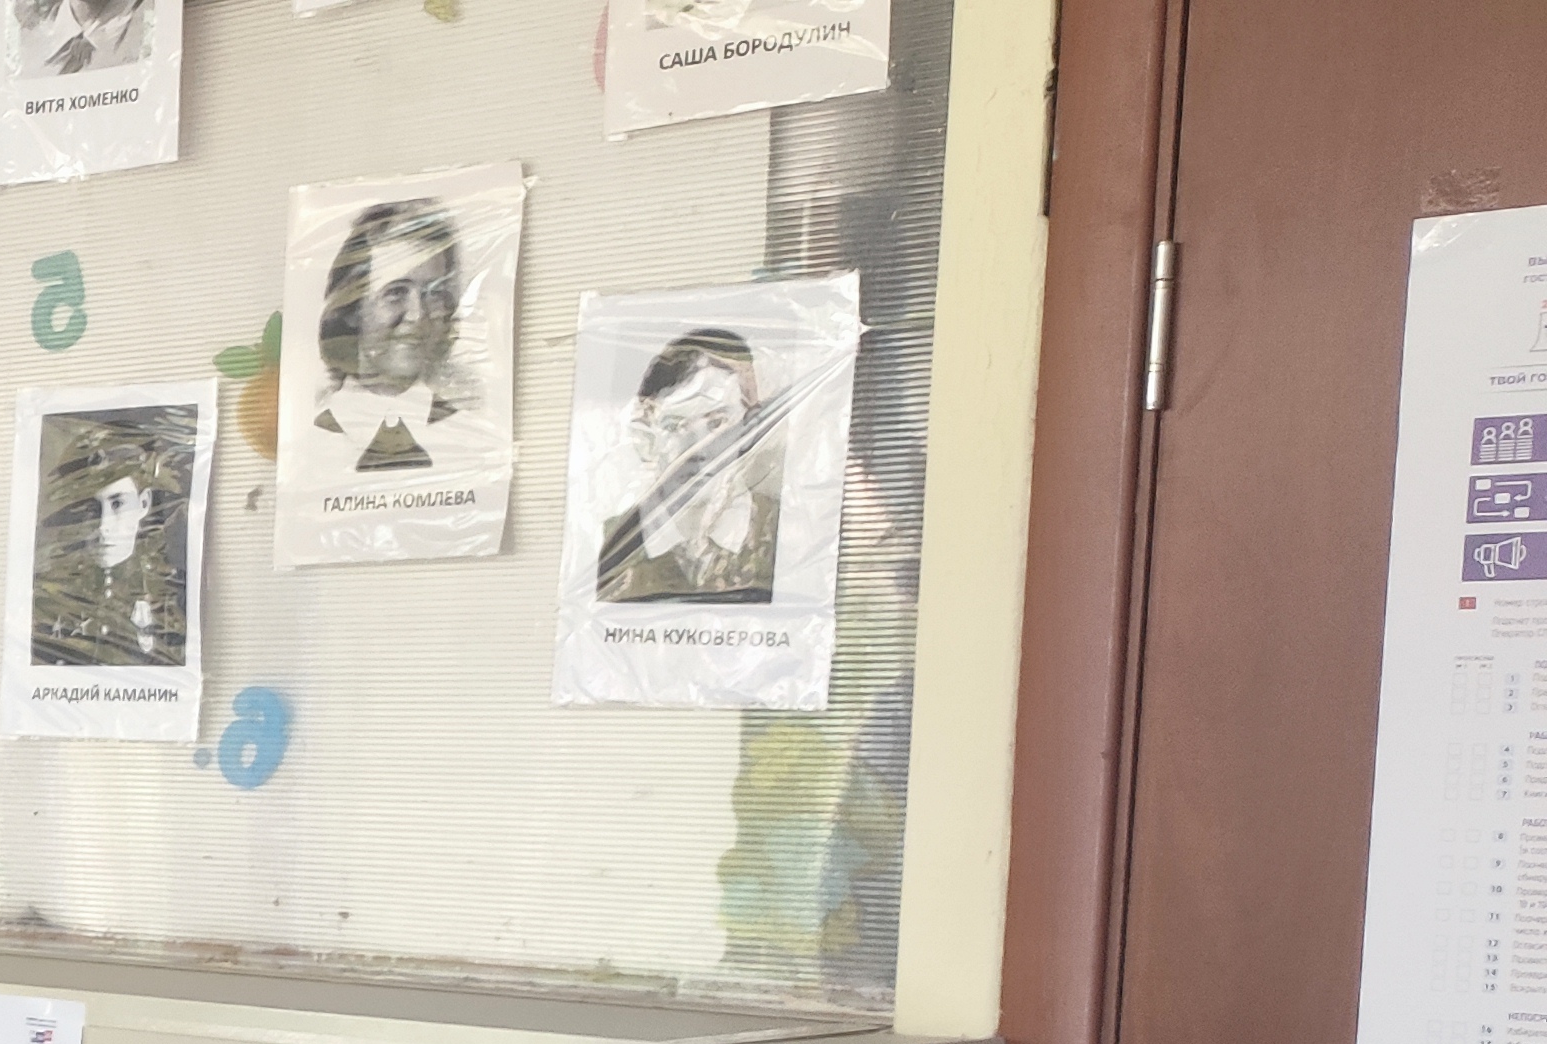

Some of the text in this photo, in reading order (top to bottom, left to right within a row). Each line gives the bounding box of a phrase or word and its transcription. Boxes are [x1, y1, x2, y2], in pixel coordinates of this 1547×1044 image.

[658, 21, 851, 70] САША БОРОДУЛИН
[25, 88, 140, 115] ВИТЯ ХОМЕНКО
[1490, 372, 1526, 386] ТВОЙ
[323, 489, 476, 513] ГАЛИНА КОМЛЕВА
[604, 627, 791, 647] НИНА КУКОВЕРОВА
[31, 684, 178, 704] АРКАДИЙ КАМАНИН
